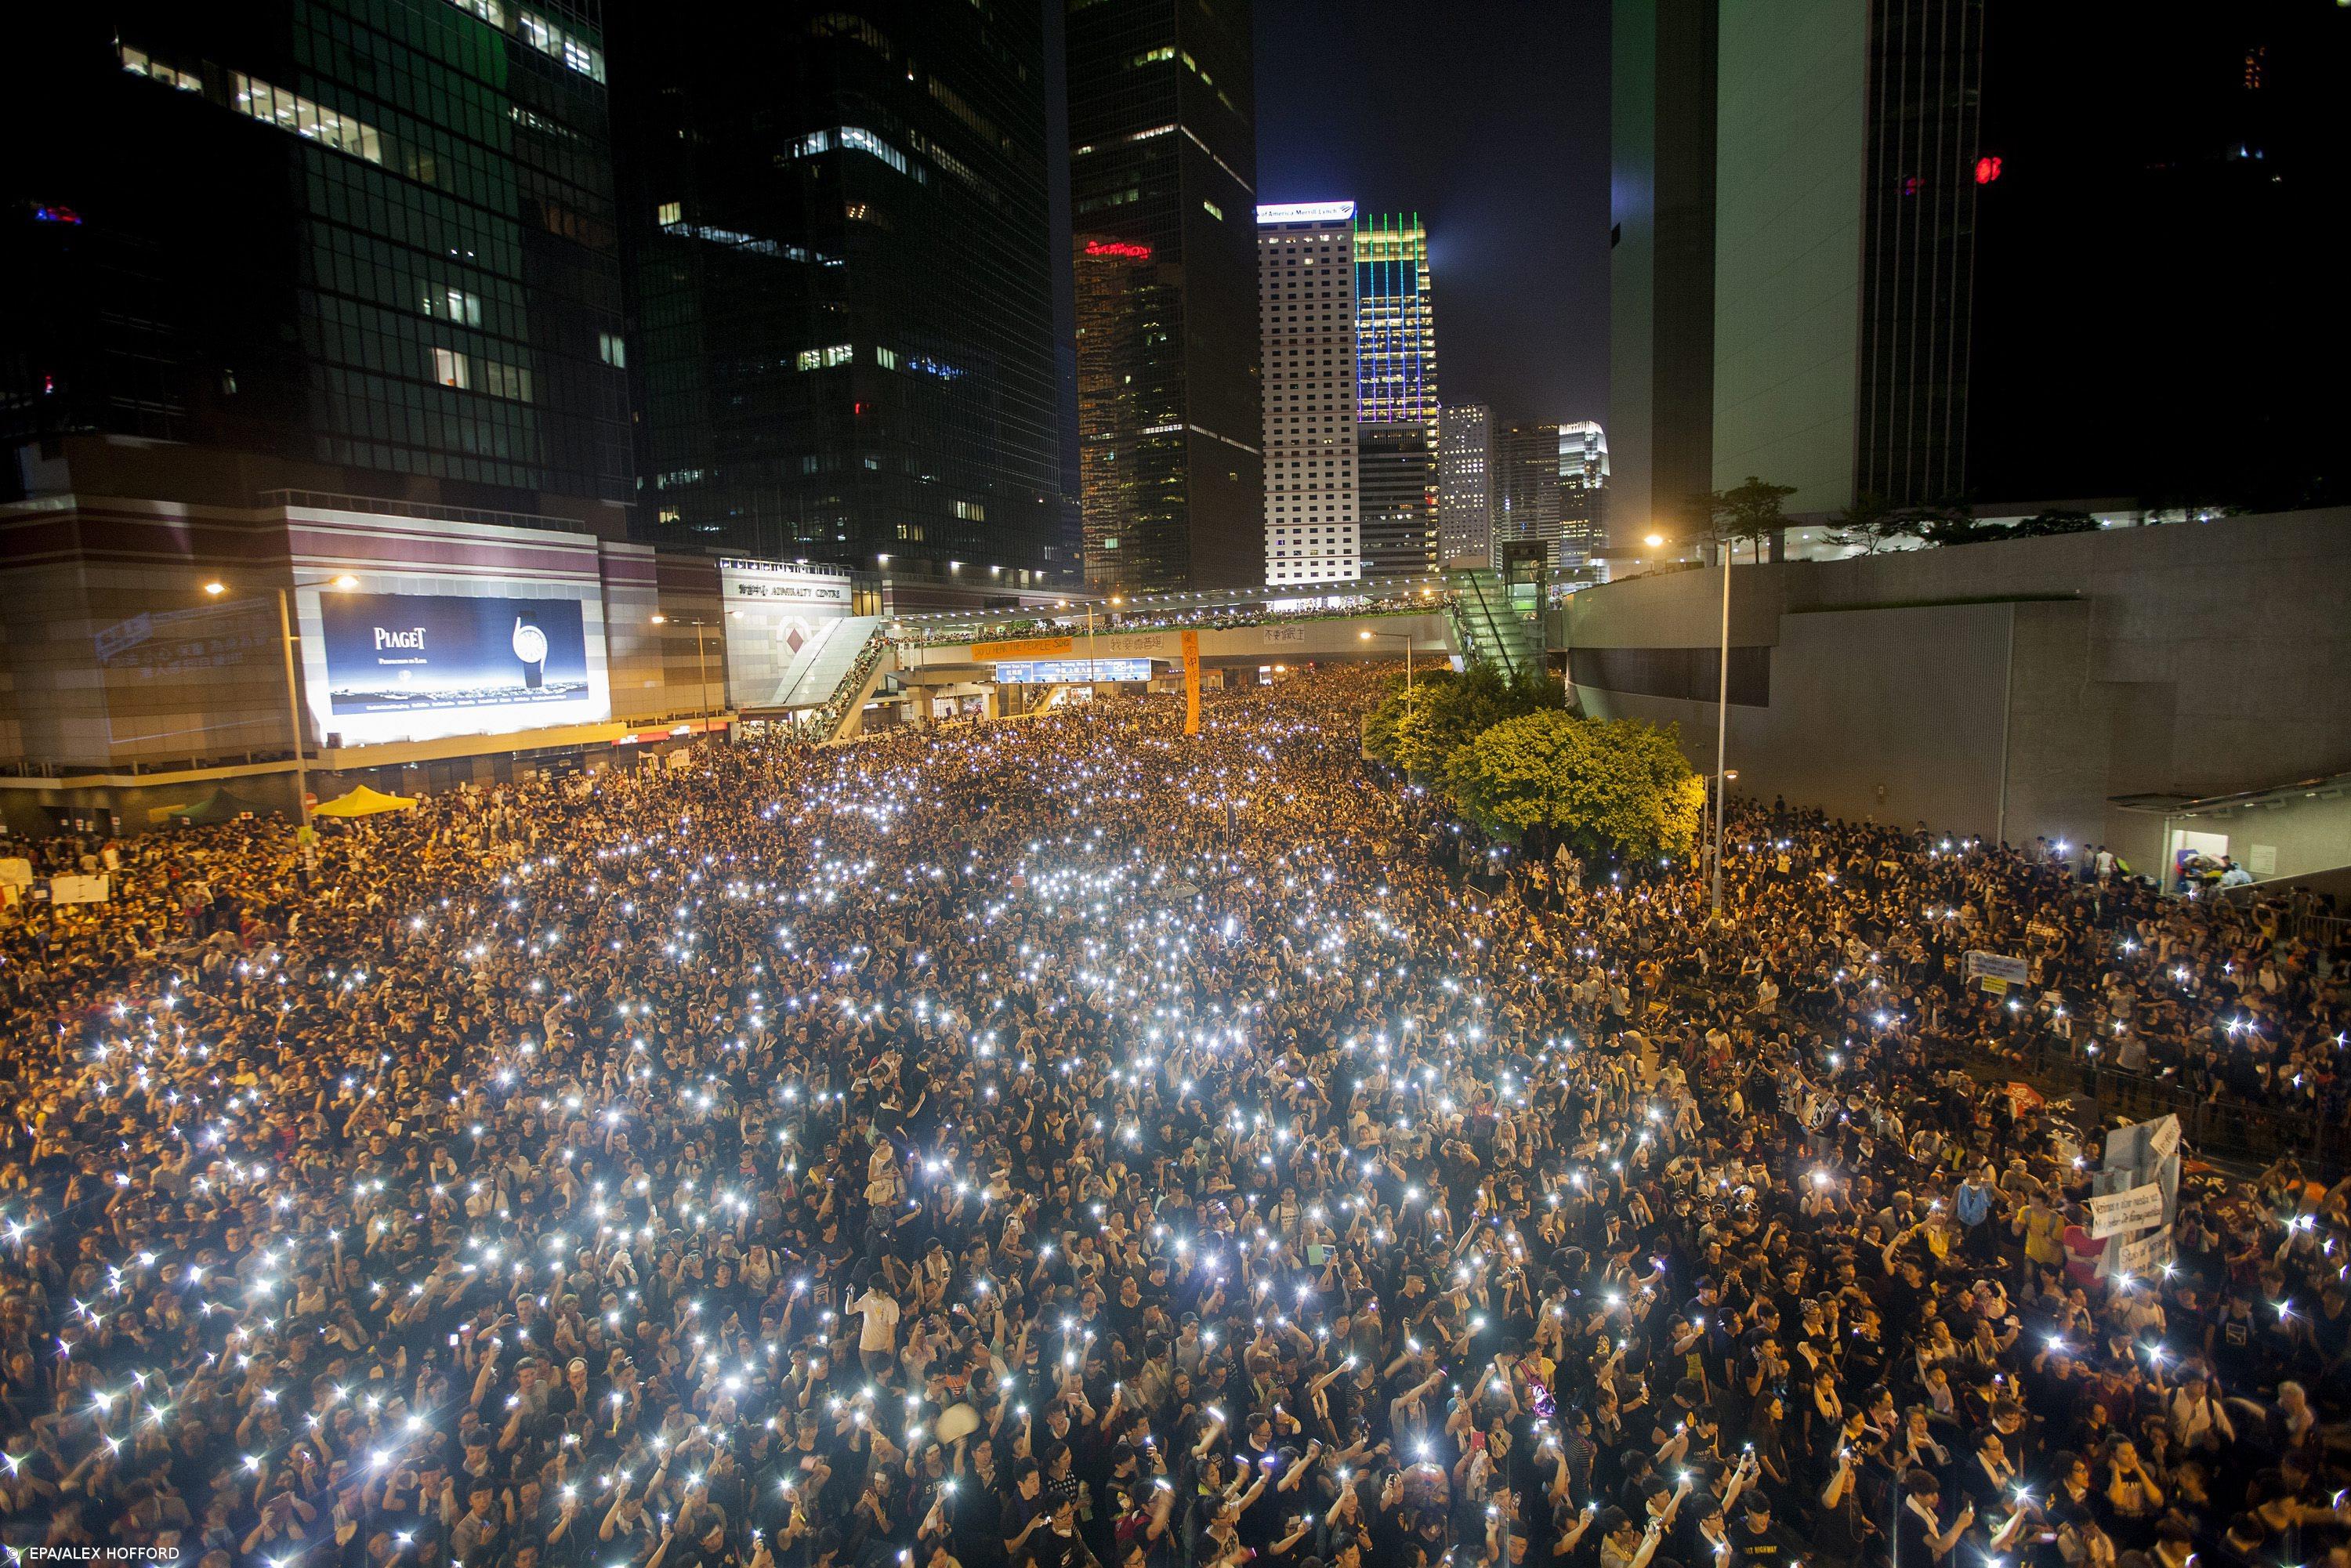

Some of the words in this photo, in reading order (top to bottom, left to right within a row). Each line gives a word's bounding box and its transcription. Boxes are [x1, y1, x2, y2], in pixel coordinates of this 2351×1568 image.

[772, 587, 813, 597] ADMIRALTY
[816, 589, 841, 599] CENTRE
[374, 627, 426, 650] PIAGET
[1009, 642, 1022, 652] THE
[1023, 640, 1051, 651] PEOPLE
[1052, 639, 1070, 648] SING
